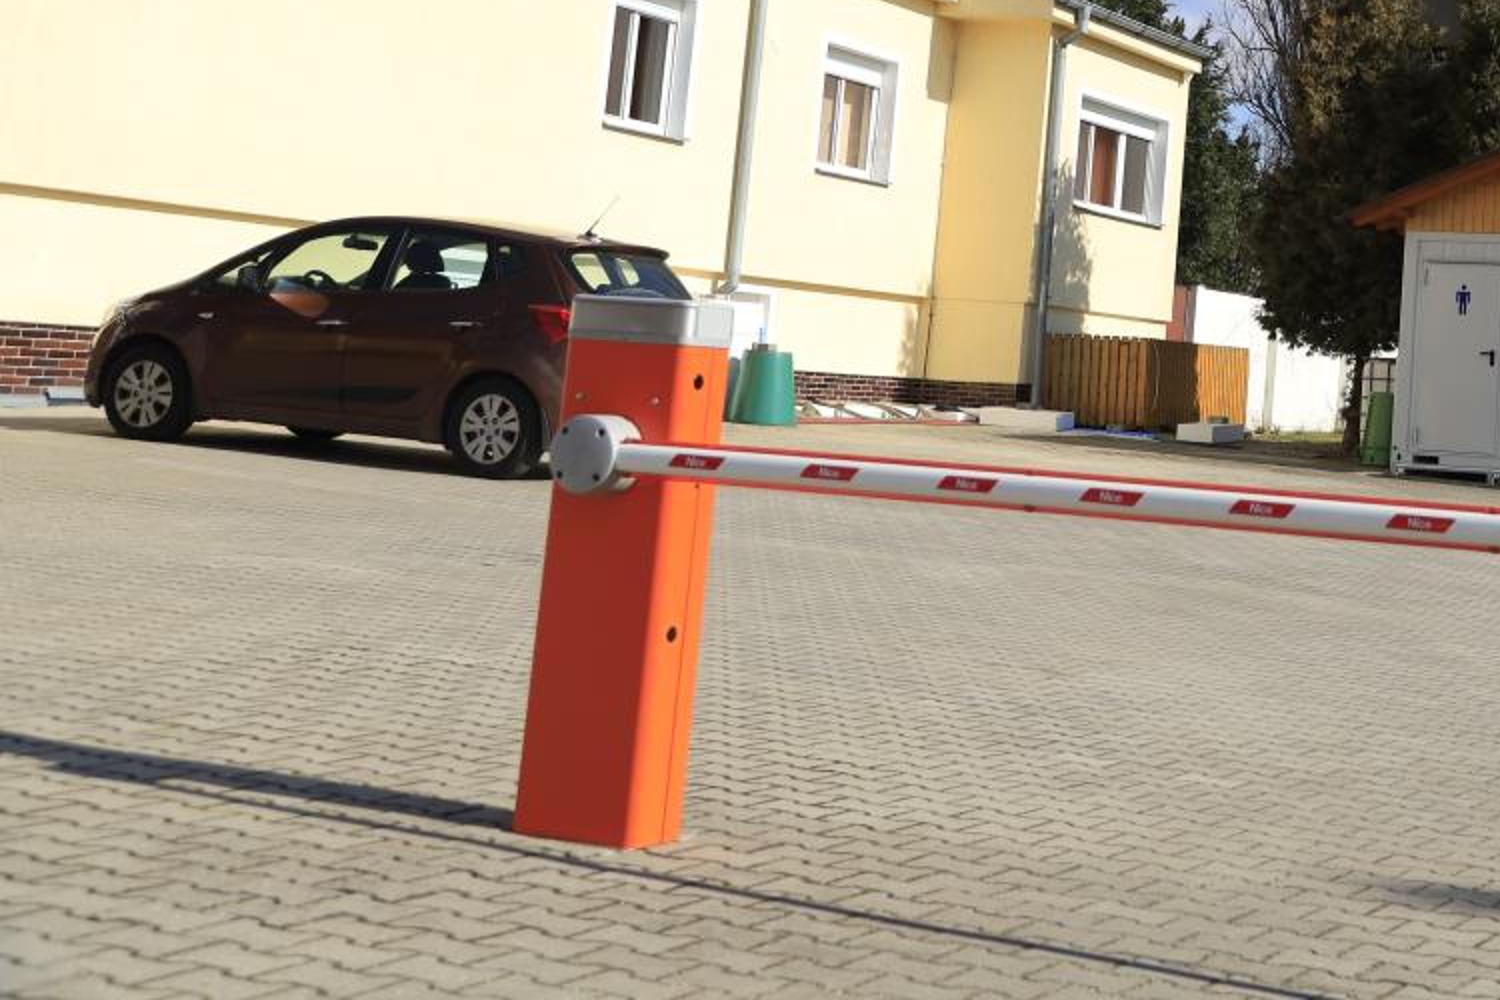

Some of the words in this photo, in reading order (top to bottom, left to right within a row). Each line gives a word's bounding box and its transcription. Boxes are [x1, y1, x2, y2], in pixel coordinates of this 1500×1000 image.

[955, 478, 977, 490] Nice
[1099, 490, 1122, 502] Nice
[1249, 503, 1273, 514] Nice
[1407, 516, 1432, 529] Nice
